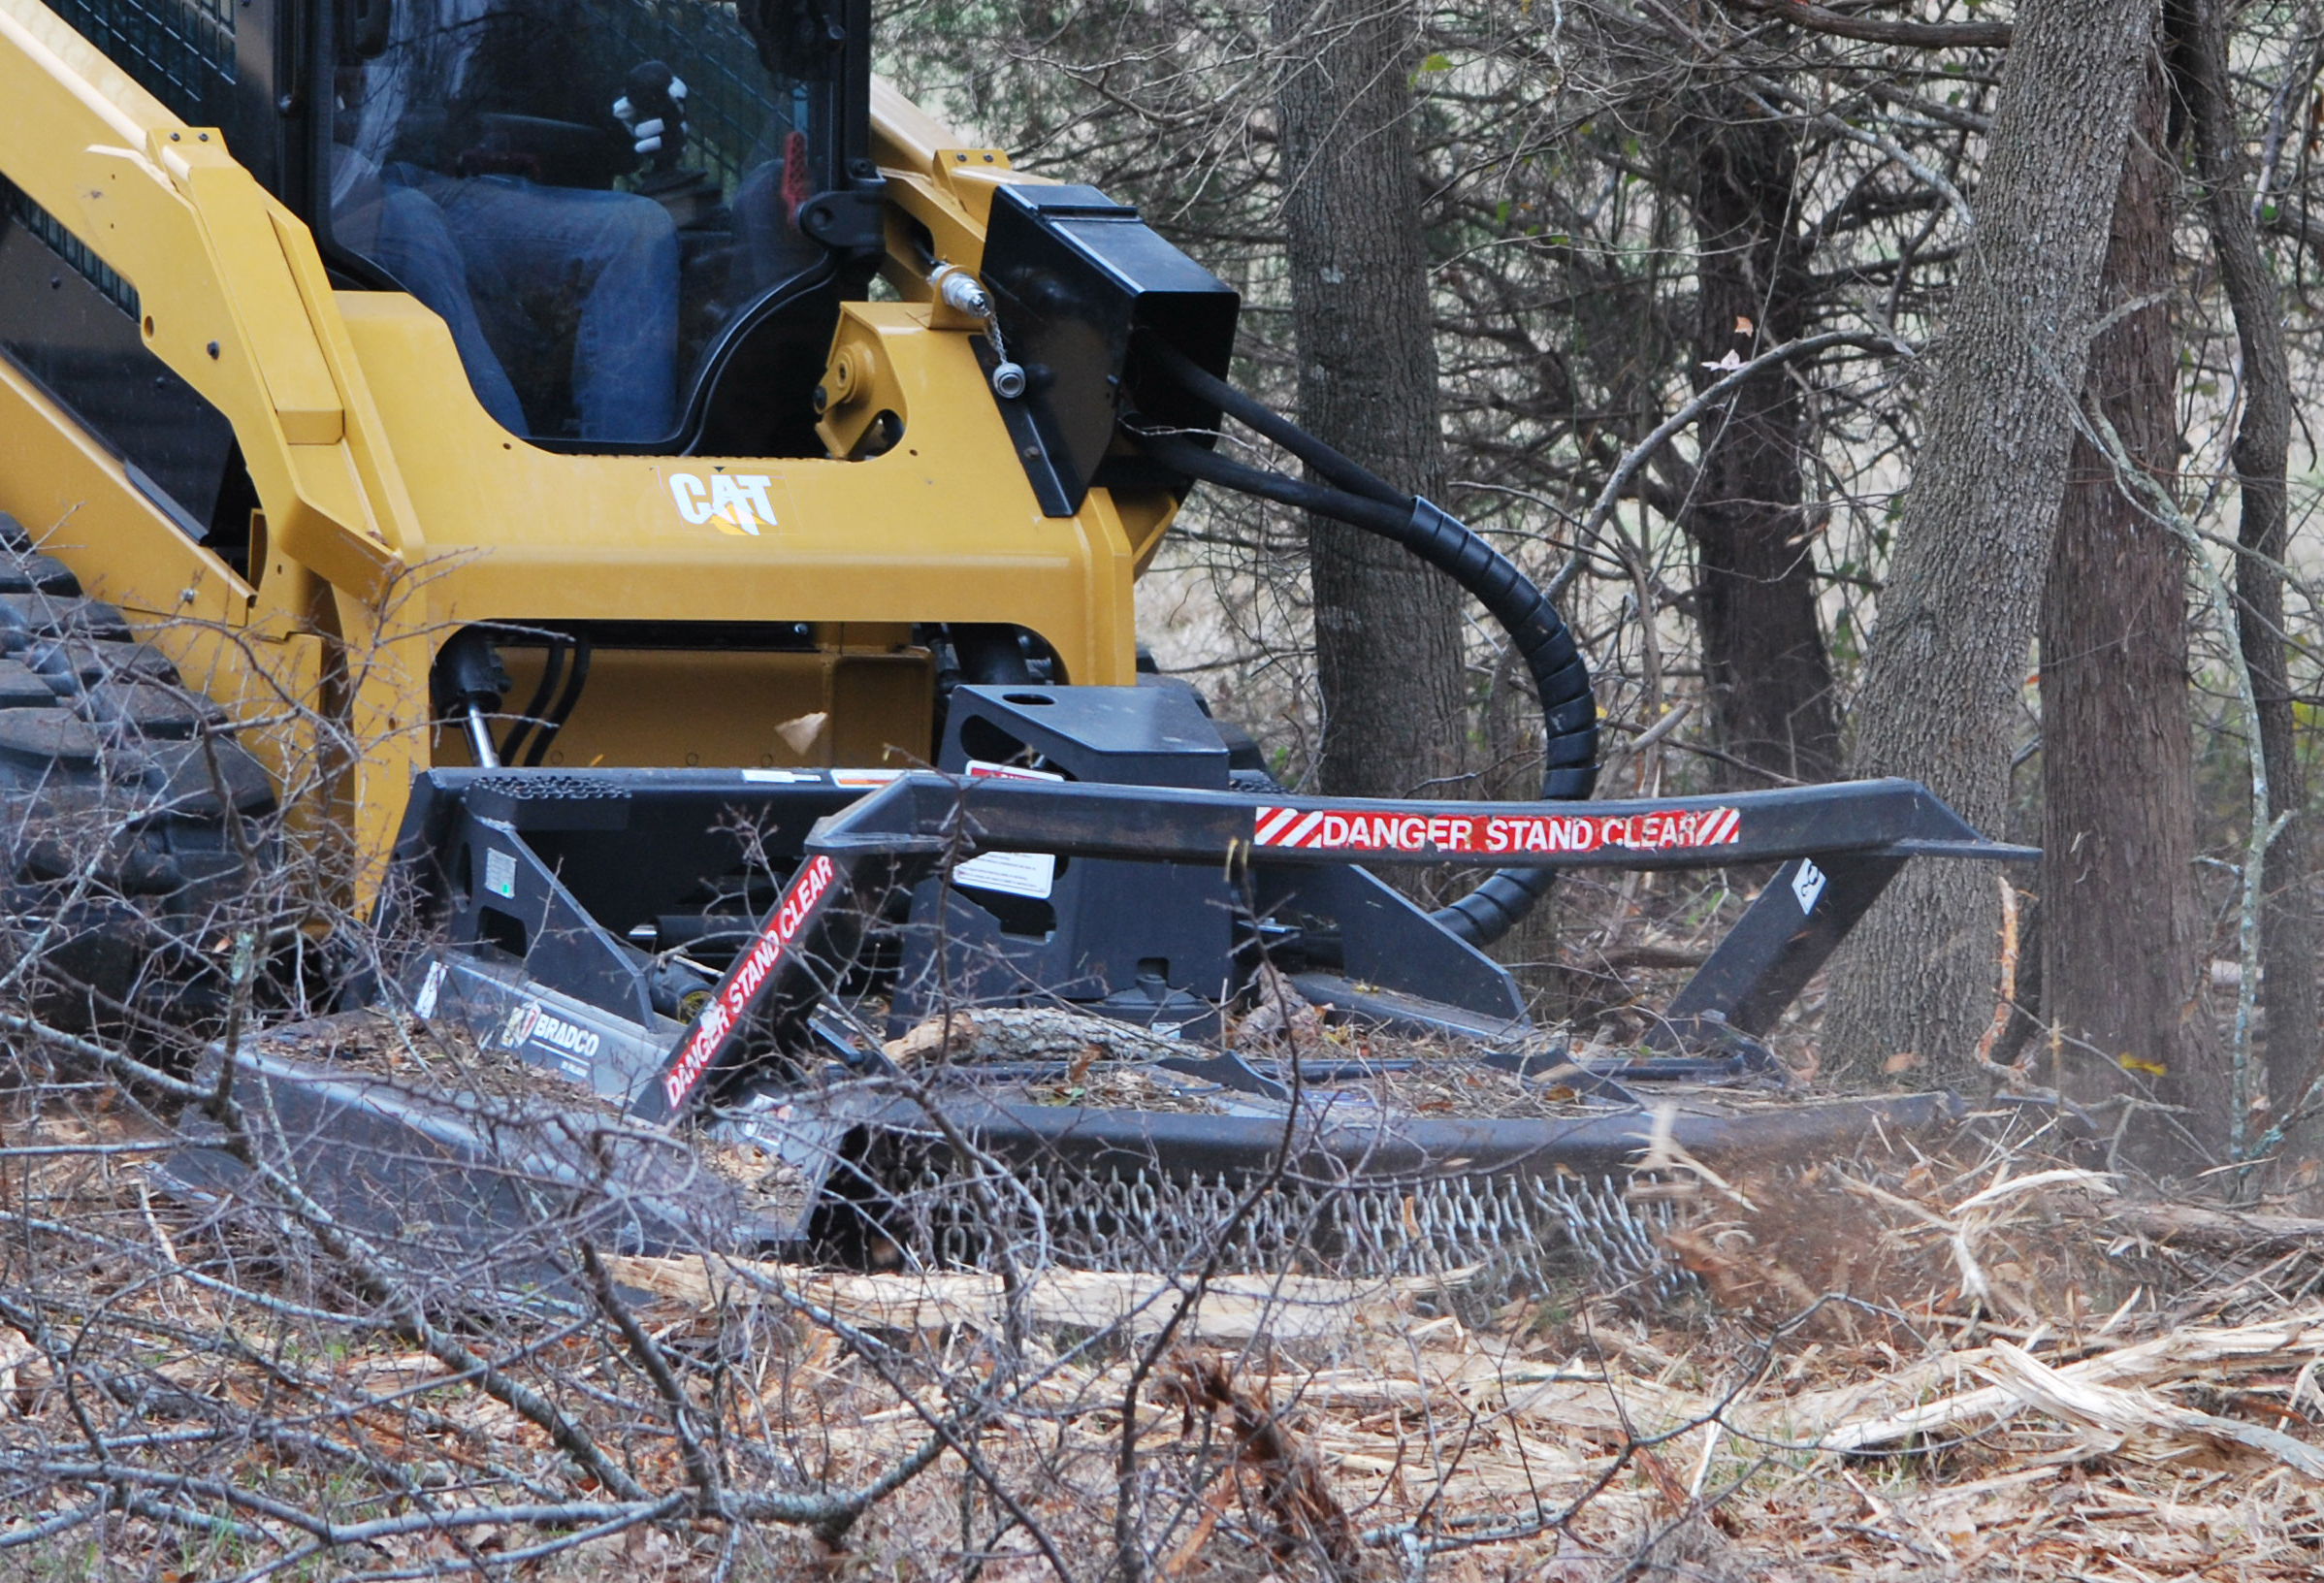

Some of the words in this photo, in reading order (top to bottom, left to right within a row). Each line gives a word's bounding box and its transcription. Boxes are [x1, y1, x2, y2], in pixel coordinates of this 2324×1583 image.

[669, 473, 778, 535] CAT
[1323, 816, 1472, 851] DANGER
[1486, 820, 1593, 850] STAND
[1602, 816, 1696, 848] CLEAR
[666, 1003, 730, 1110] DANGER
[727, 930, 780, 1015] STAND
[780, 856, 833, 939] CLEAR
[533, 1013, 599, 1057] BRADCO
